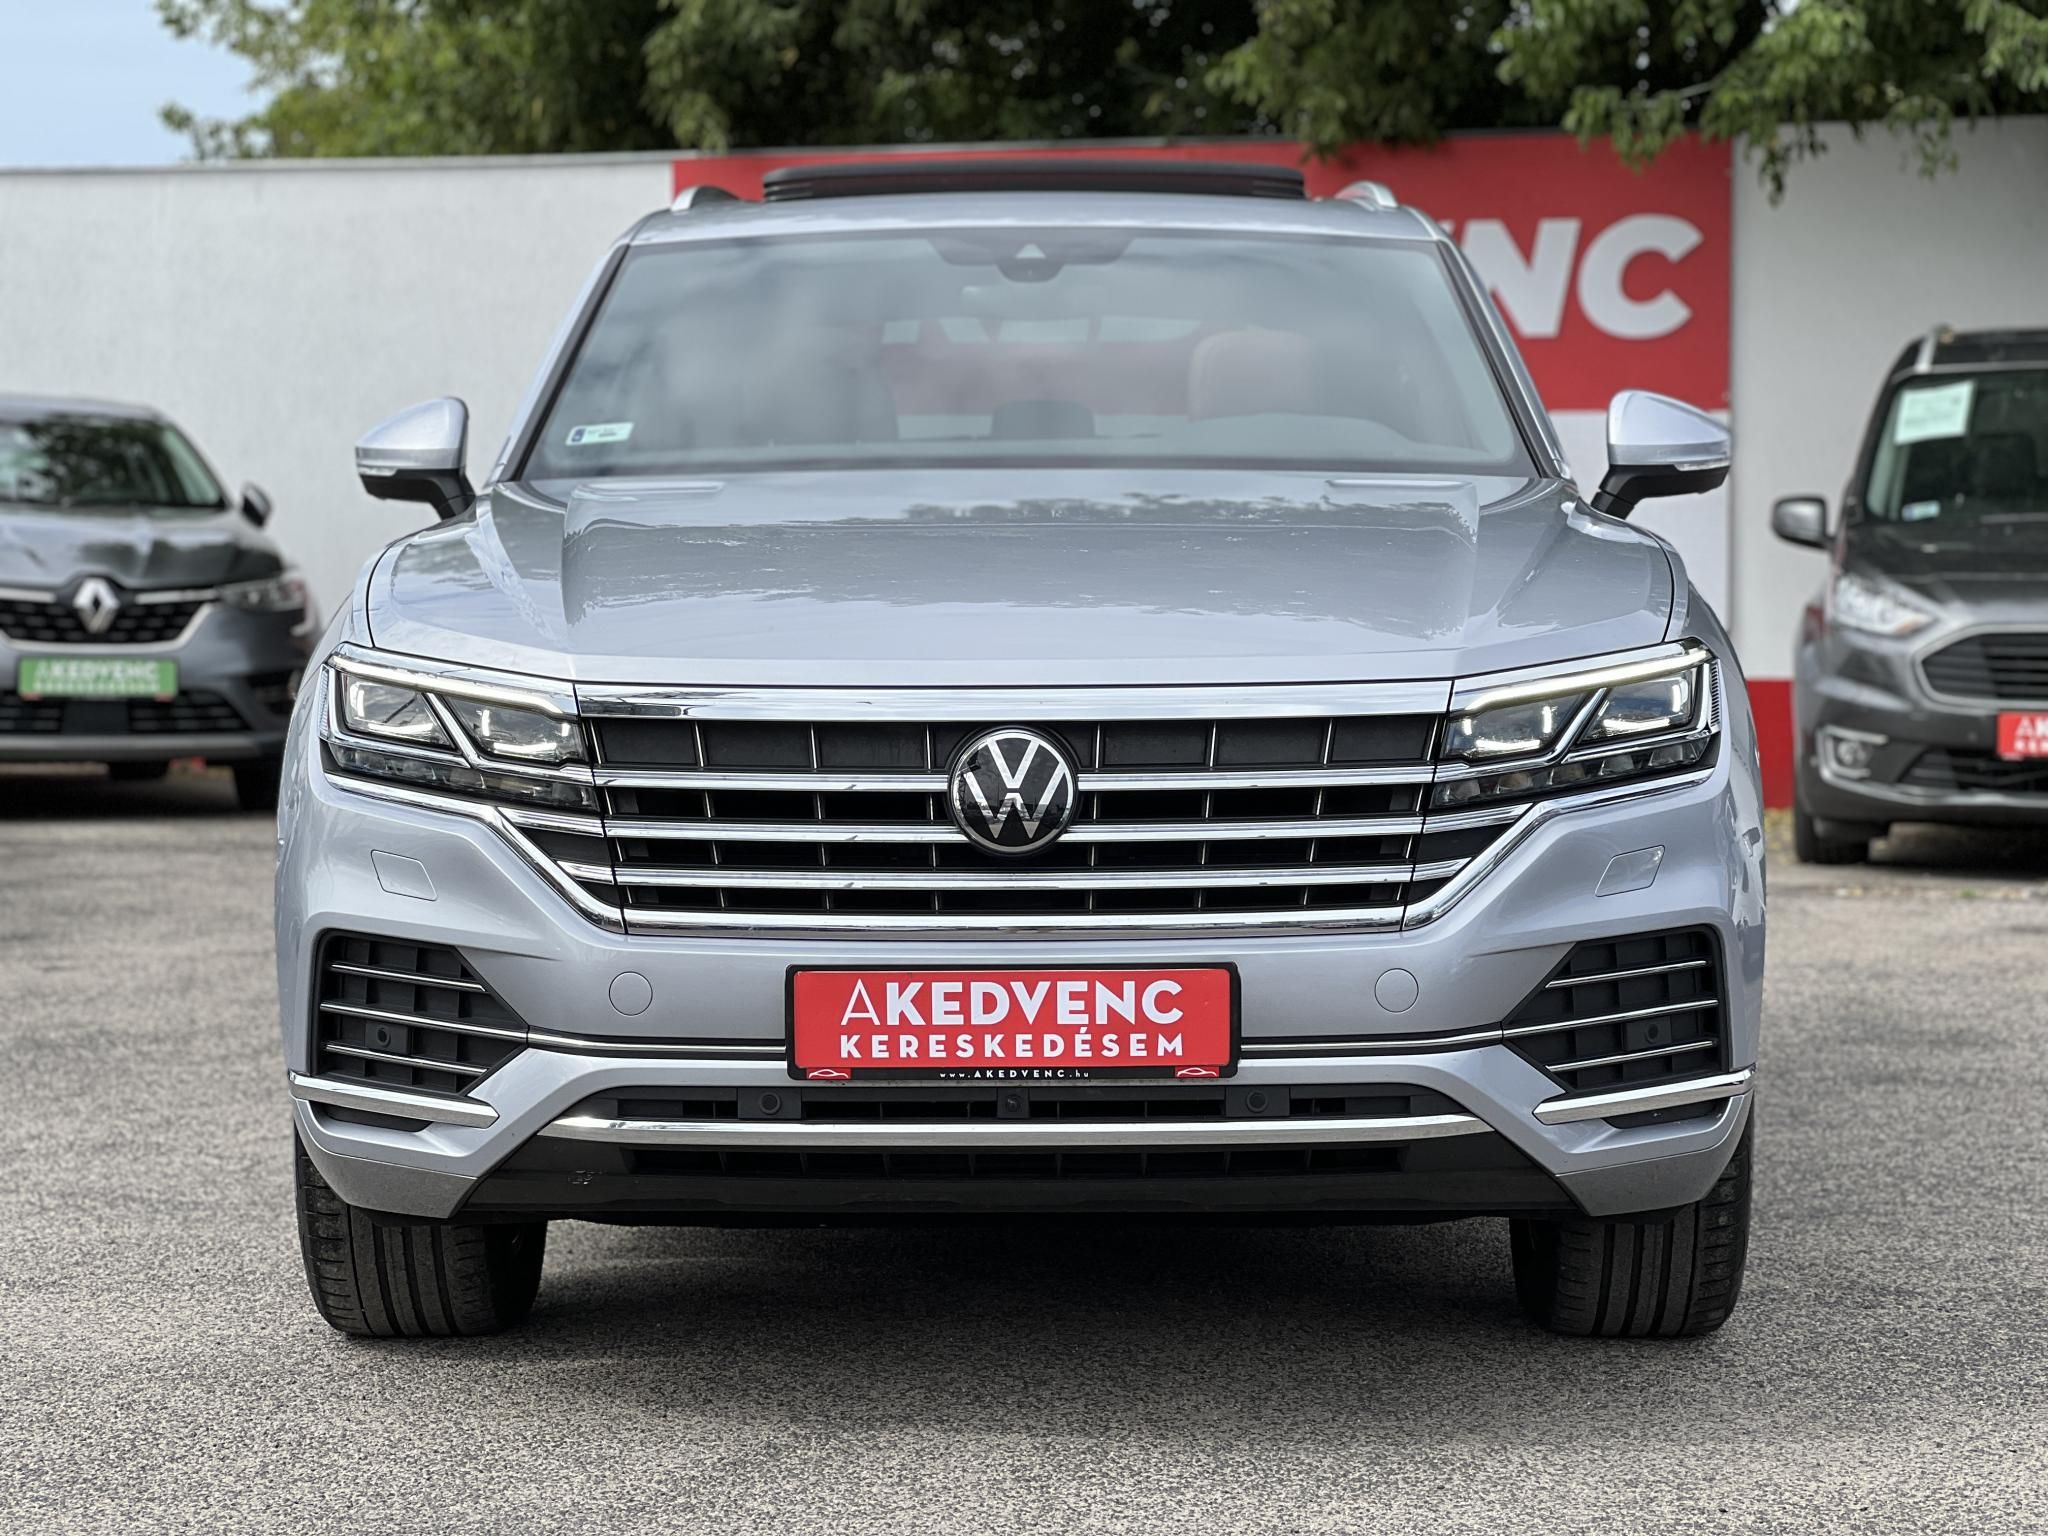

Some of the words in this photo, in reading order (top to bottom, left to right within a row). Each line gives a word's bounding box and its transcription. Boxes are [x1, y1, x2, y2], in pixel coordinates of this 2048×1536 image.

[1441, 213, 1703, 339] NC
[840, 1027, 1183, 1058] KERESKEDÉSEM
[939, 1069, 1090, 1079] www.AKEDVENC.hu
